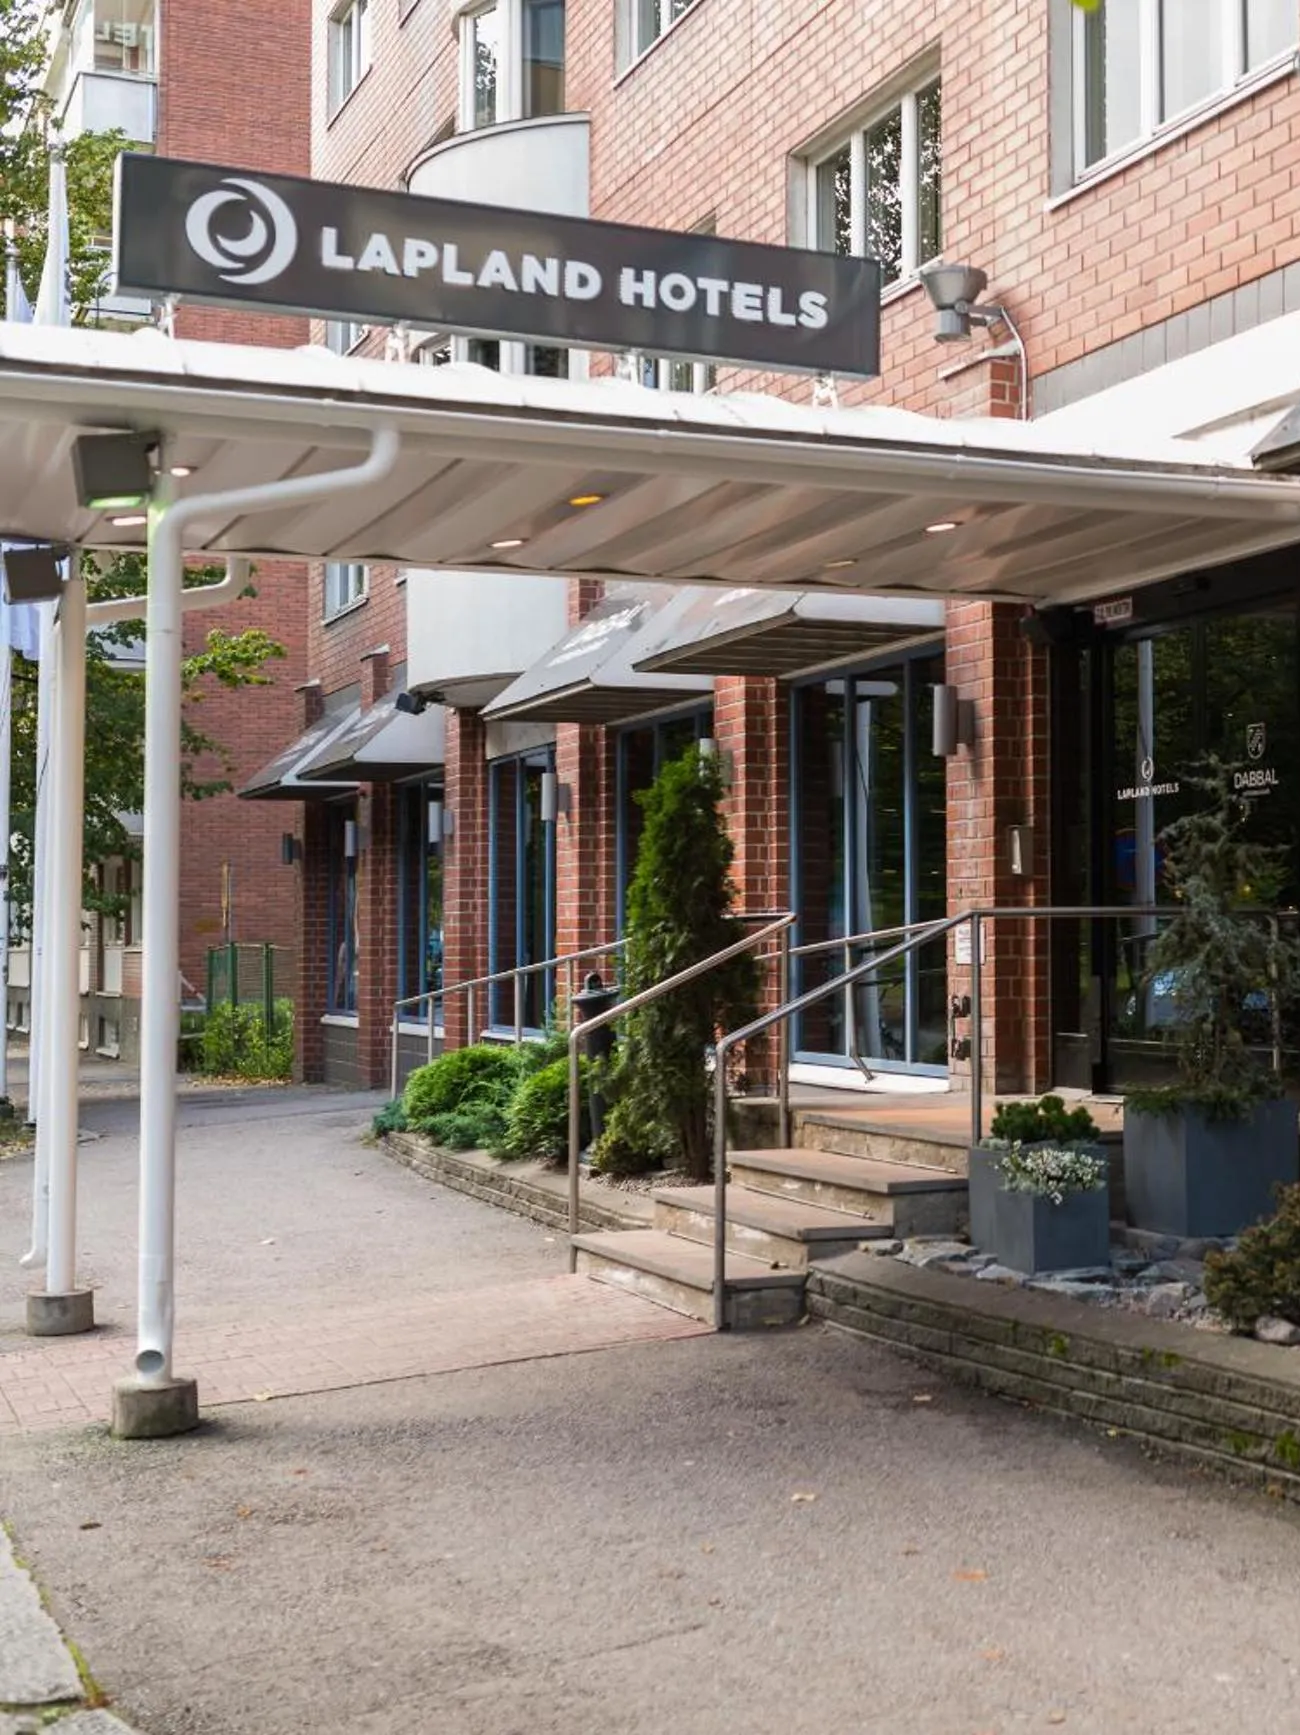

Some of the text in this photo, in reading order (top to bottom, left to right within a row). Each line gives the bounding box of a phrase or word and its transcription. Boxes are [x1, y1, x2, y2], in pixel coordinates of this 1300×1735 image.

[321, 226, 829, 330] LAPLAND HOTELS
[1234, 768, 1279, 789] DABBAL
[1117, 782, 1179, 800] LAPLAND HOTELS
